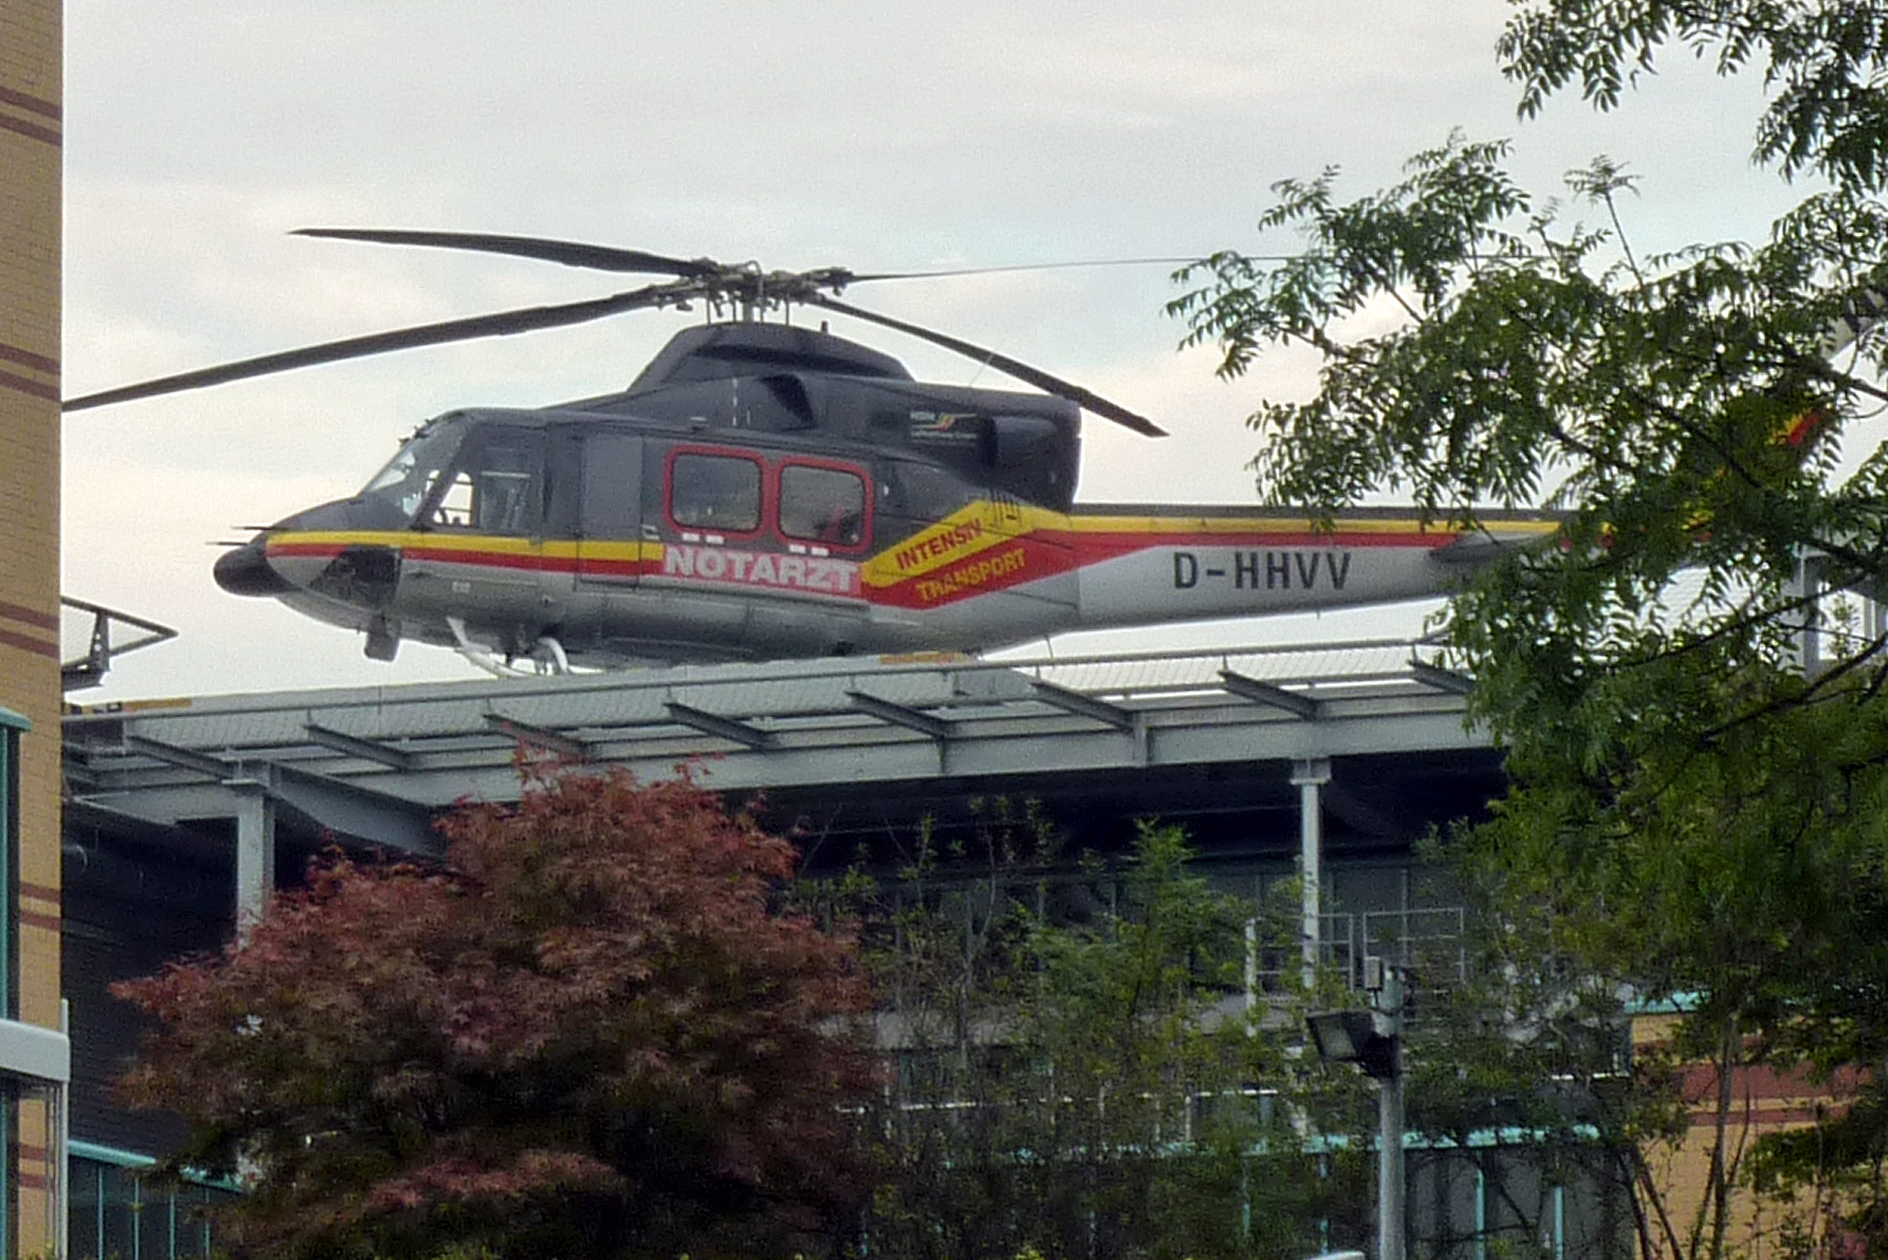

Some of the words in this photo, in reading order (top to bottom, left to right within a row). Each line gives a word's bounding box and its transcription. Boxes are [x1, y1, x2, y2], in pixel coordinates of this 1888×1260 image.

[895, 518, 984, 570] INTENSIV
[666, 546, 858, 591] NOTARZT
[916, 548, 1026, 601] TRANSPORT
[1173, 552, 1352, 589] D-HHVV
